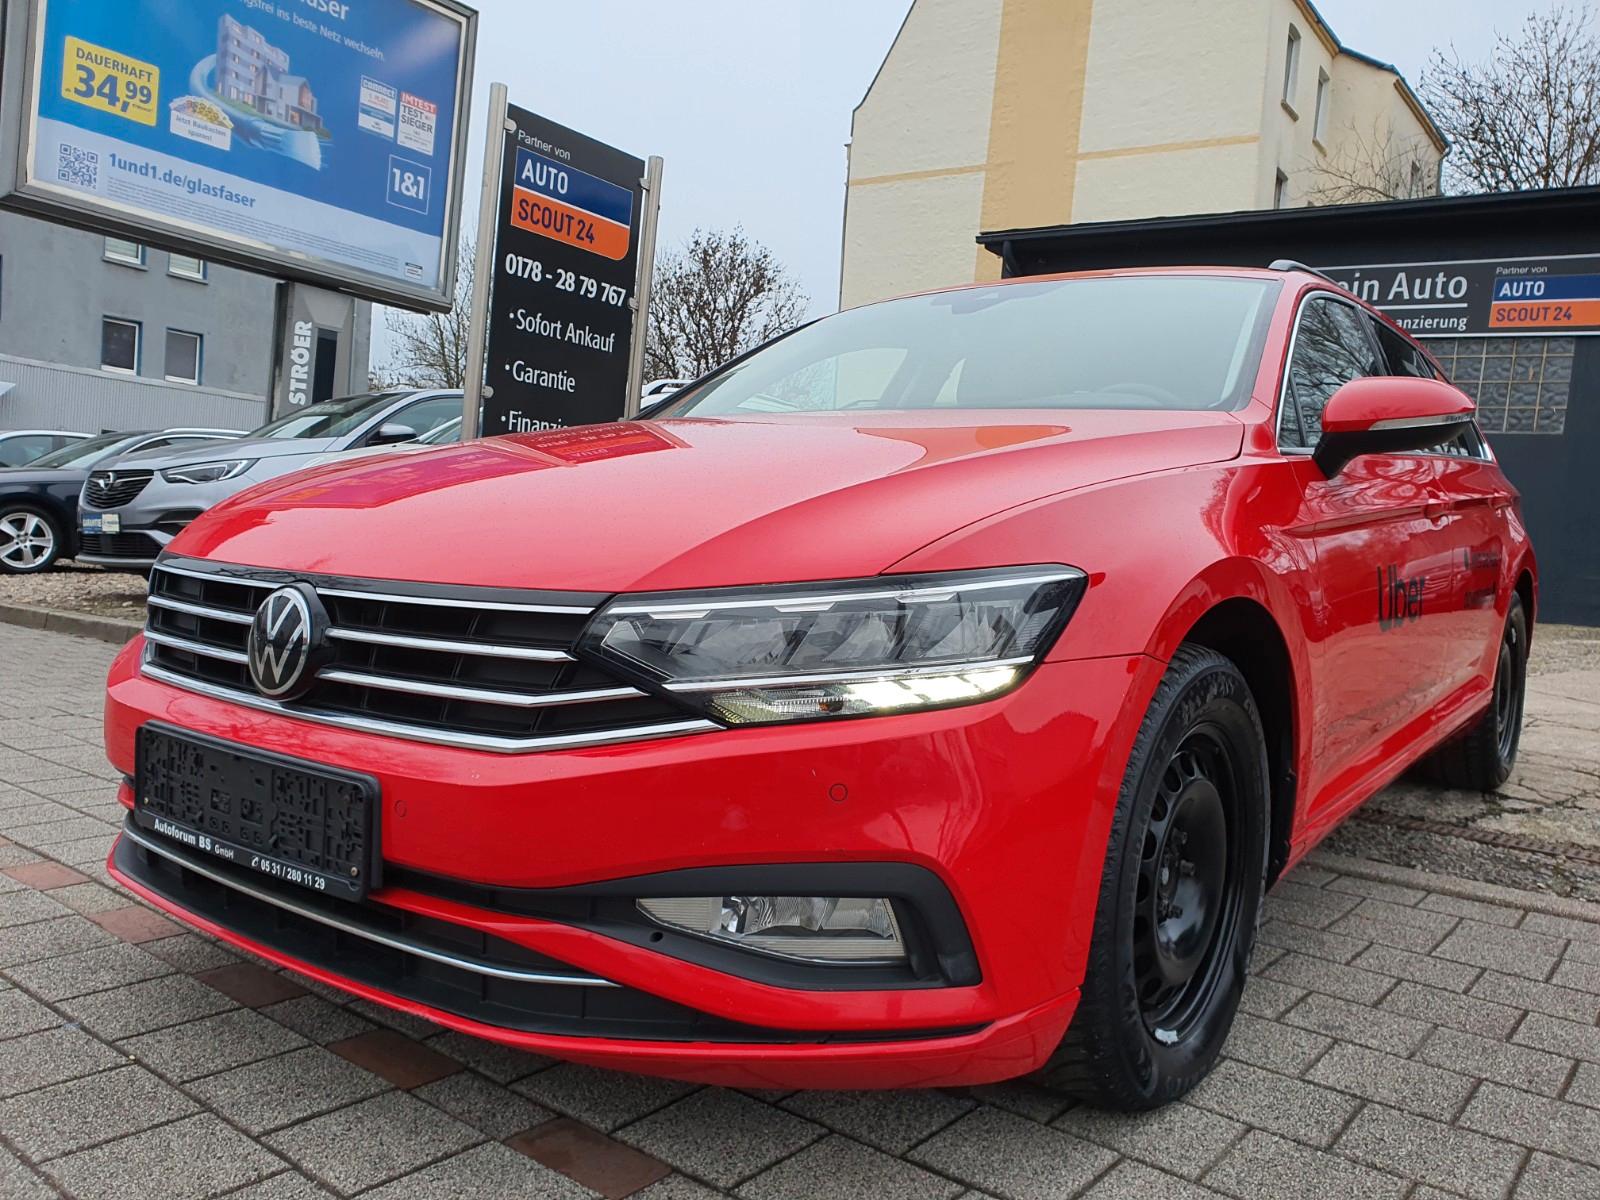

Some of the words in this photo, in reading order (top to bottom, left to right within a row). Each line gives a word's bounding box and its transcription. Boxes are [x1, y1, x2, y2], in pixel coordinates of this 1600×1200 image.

[276, 7, 290, 21] ins
[292, 12, 318, 33] beste
[319, 24, 342, 44] Netz
[76, 47, 153, 83] DAUERHAFT
[401, 104, 424, 120] TEST
[401, 114, 433, 134] SIEGER
[518, 129, 552, 152] Partner
[554, 146, 571, 161] von
[109, 153, 256, 208] 1und1.de/glasfaser
[392, 167, 425, 200] 1&1
[521, 158, 569, 195] AUTO
[505, 253, 543, 282] 0178
[555, 268, 576, 292] 28
[579, 275, 598, 299] 79
[601, 282, 627, 307] 767
[1387, 271, 1468, 301] Auto
[1496, 266, 1529, 275] Partner
[1531, 265, 1548, 274] von
[1500, 280, 1545, 298] AUTO
[516, 308, 562, 340] Sofort
[565, 322, 616, 353] Ankauf
[288, 320, 313, 406] STRÖER
[512, 360, 576, 393] Garantie
[1376, 563, 1425, 632] Uber
[154, 818, 196, 846] Autoforum
[199, 835, 211, 851] BS
[215, 845, 234, 860] GmbH
[260, 859, 270, 872] 05
[272, 862, 281, 877] 31
[287, 868, 301, 882] 280
[304, 873, 312, 887] 11
[314, 876, 325, 891] 29
